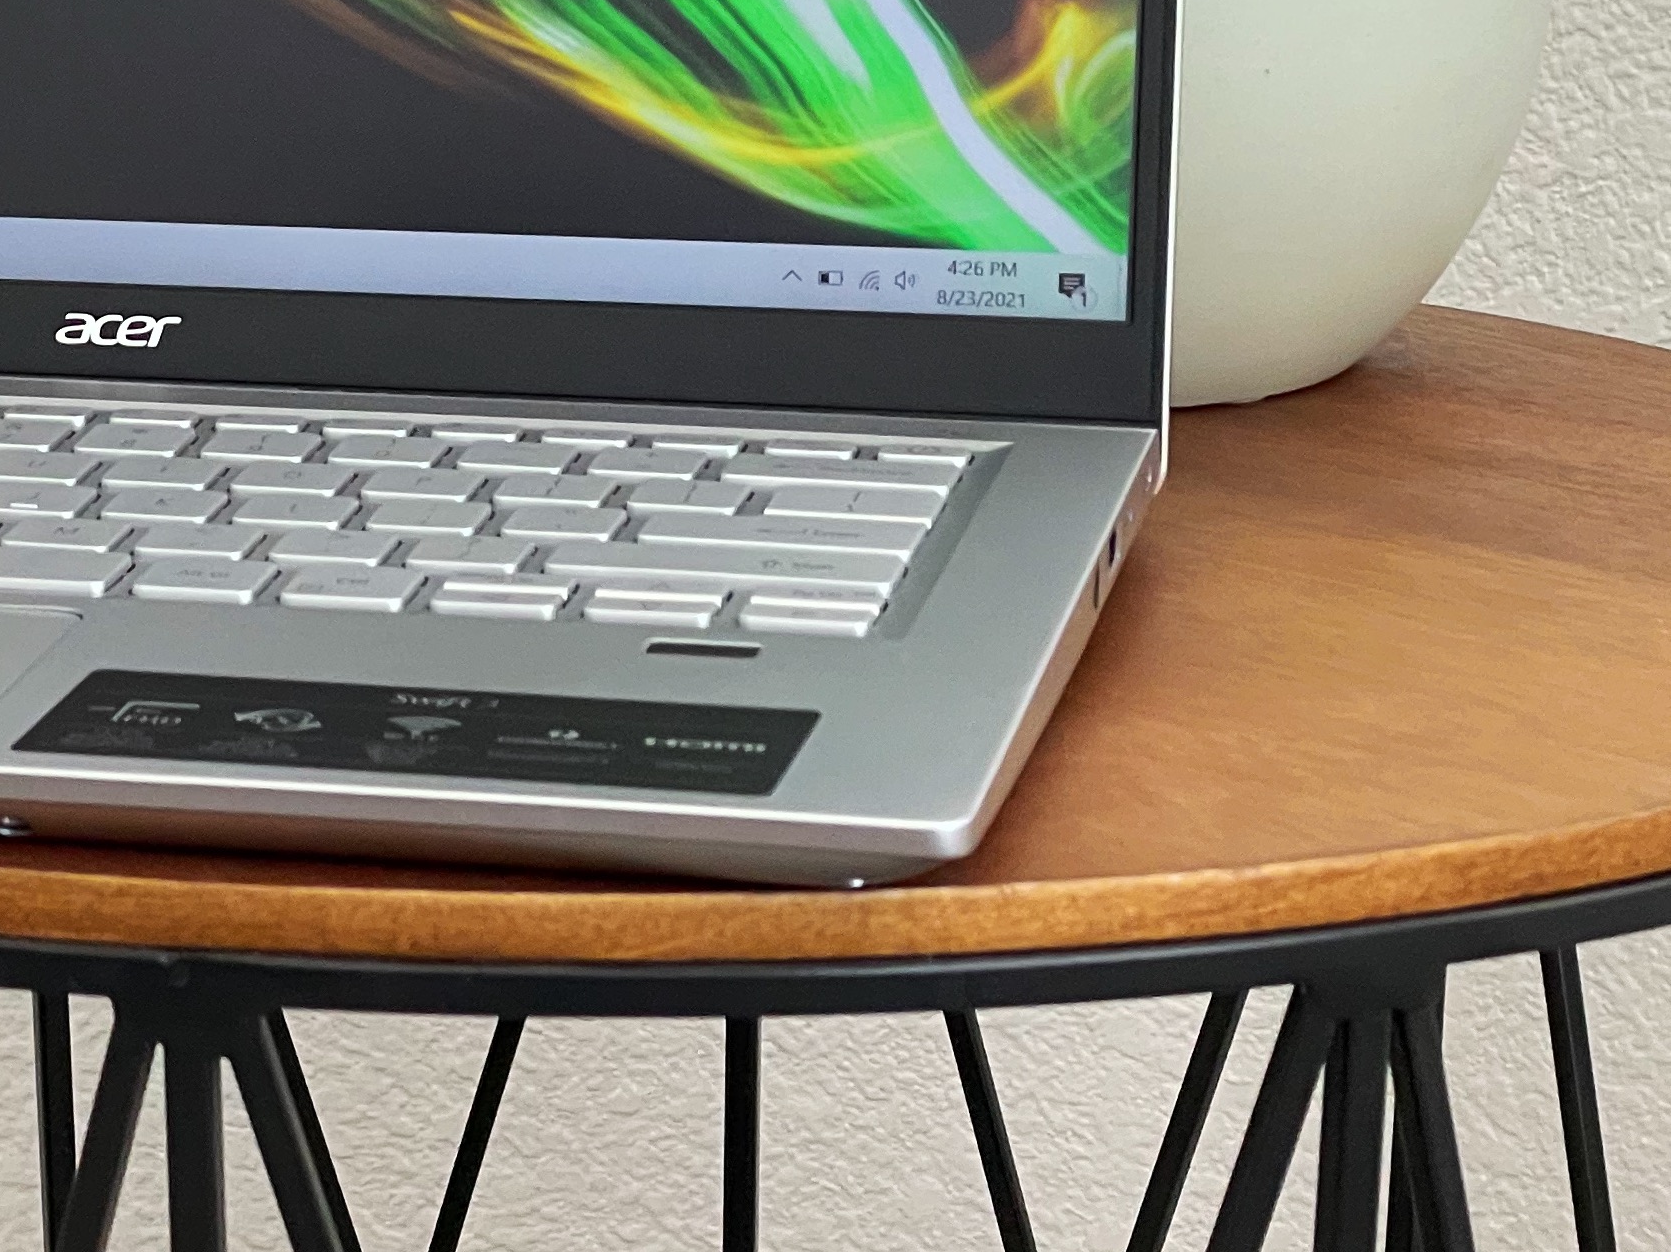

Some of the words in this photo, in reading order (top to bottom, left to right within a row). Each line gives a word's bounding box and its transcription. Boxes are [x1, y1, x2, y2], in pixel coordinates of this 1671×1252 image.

[947, 260, 984, 277] 4:26
[990, 261, 1018, 278] PM
[936, 289, 1026, 308] 8/23/2021
[55, 312, 182, 348] acer
